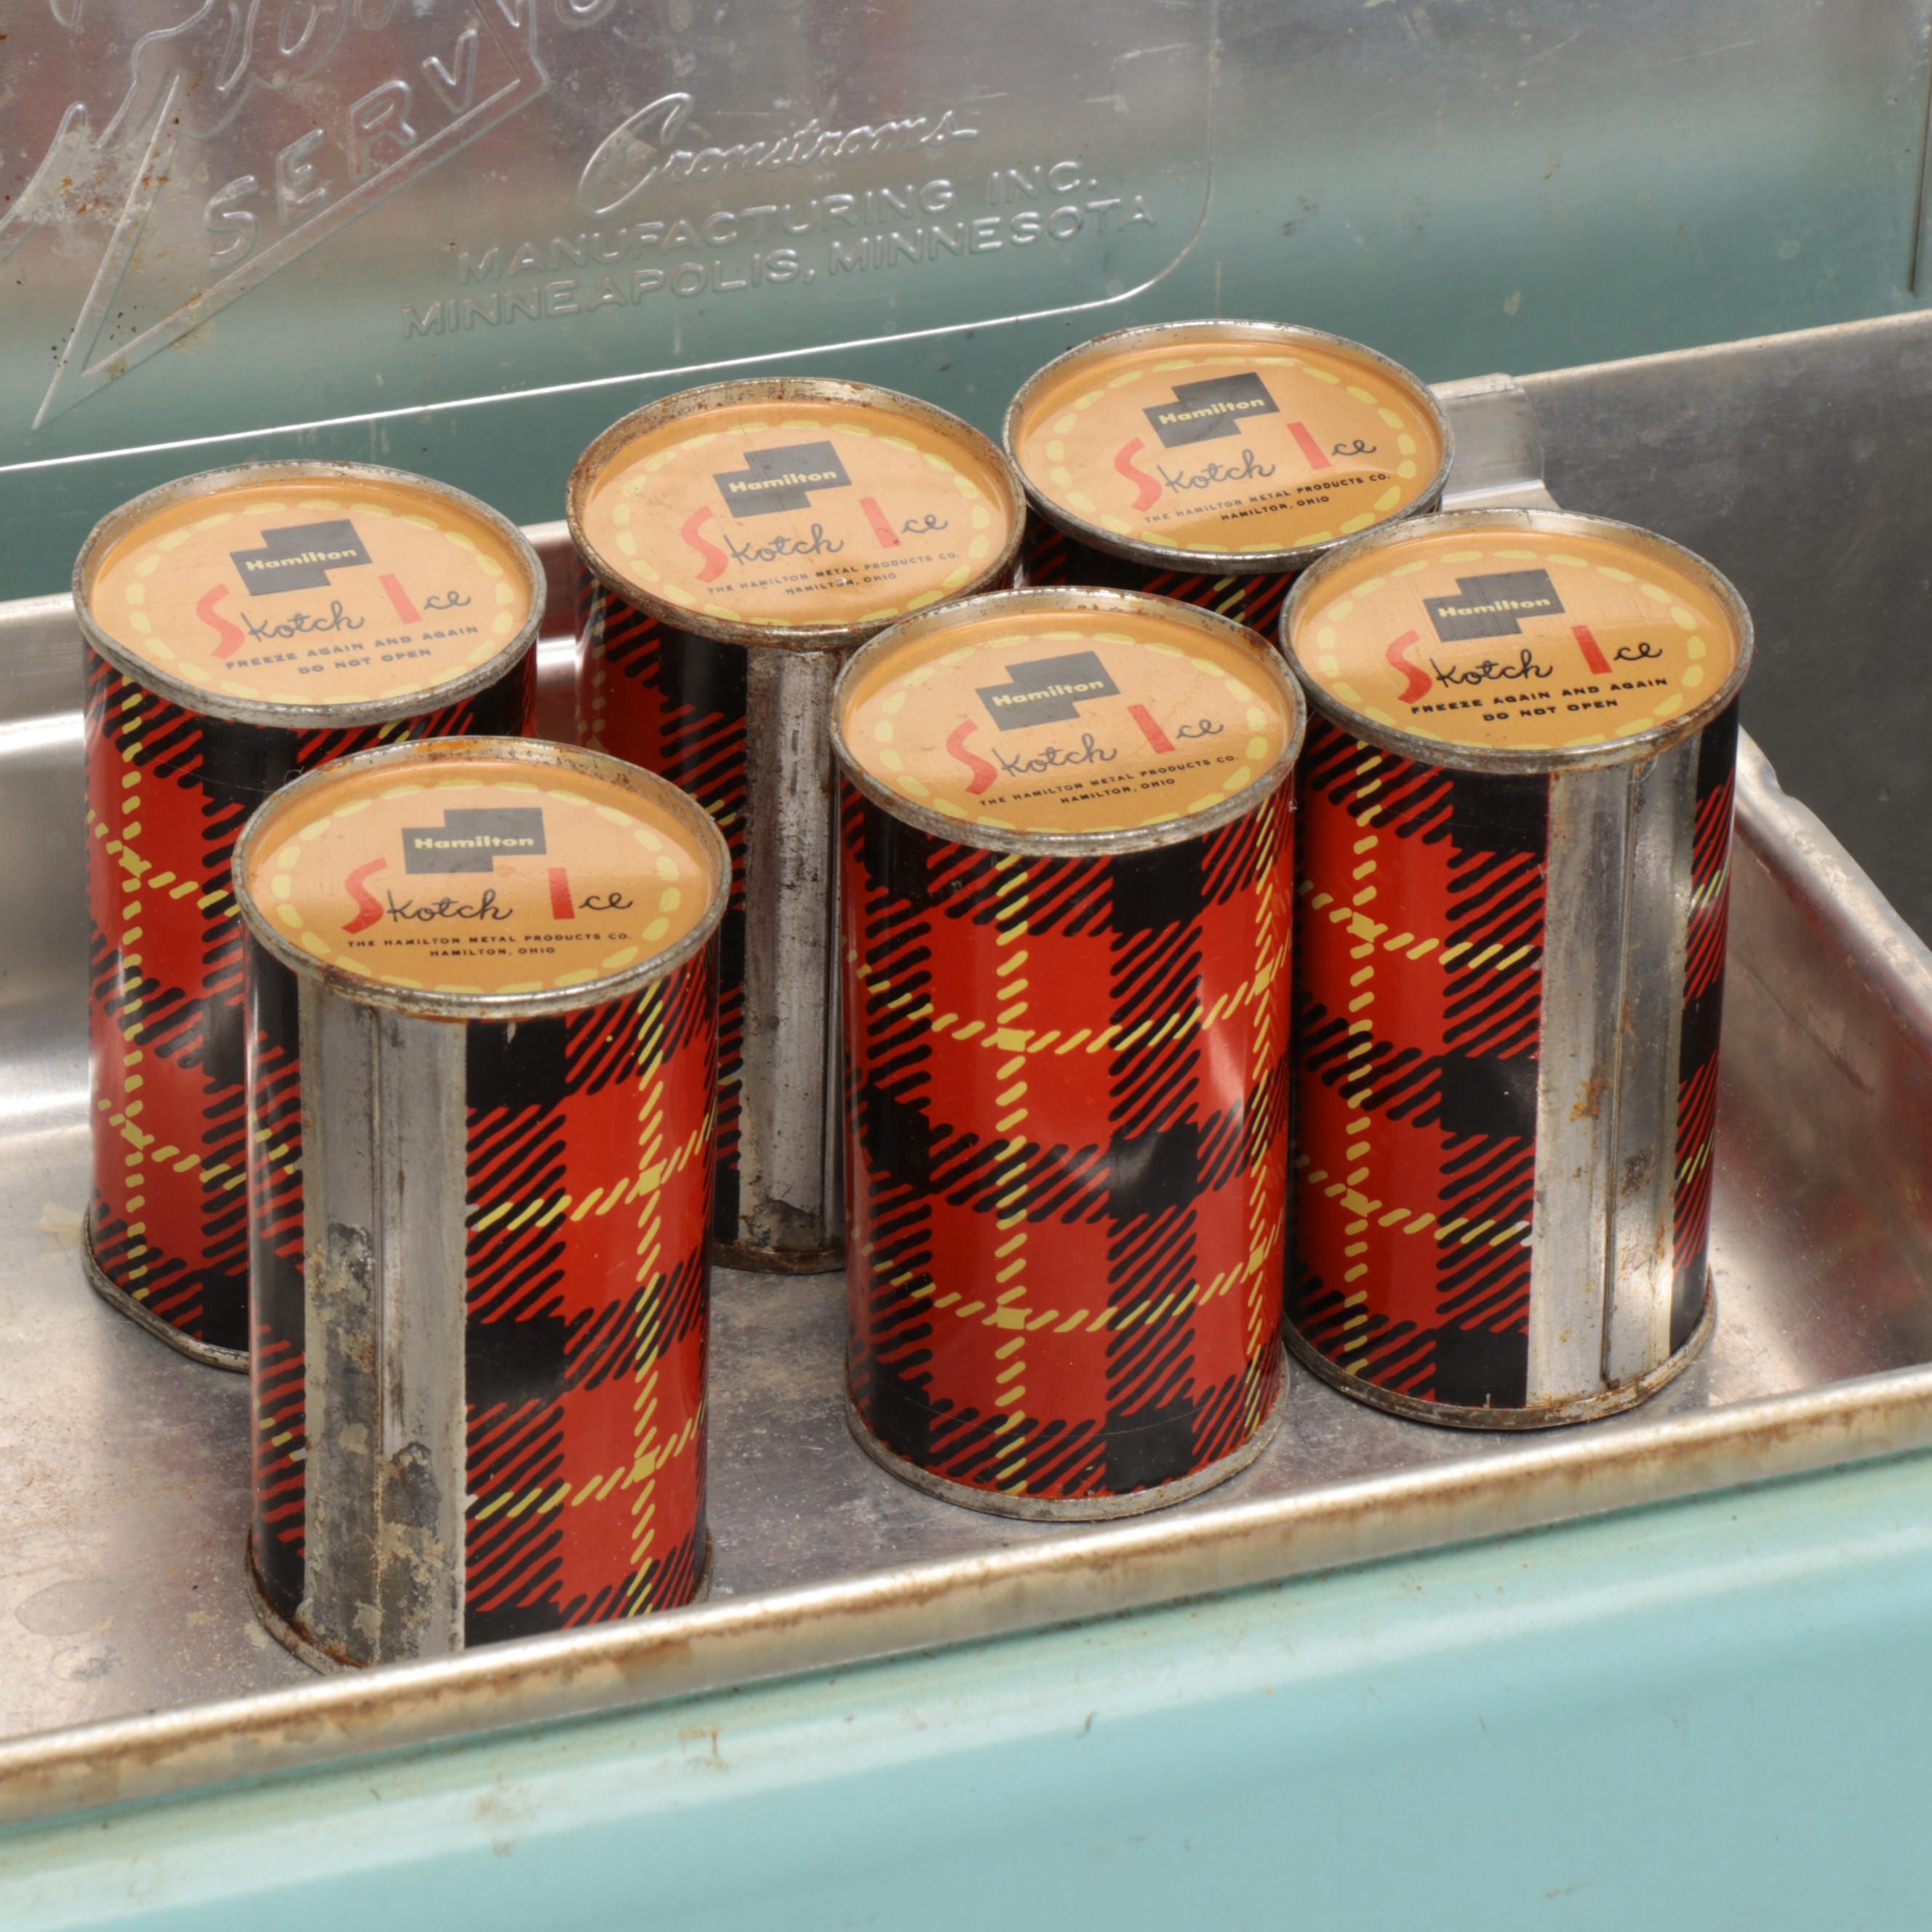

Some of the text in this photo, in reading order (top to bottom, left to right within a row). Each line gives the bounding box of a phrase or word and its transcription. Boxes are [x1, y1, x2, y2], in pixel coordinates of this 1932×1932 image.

[458, 161, 1097, 285] MANUFACTURING INC.
[402, 194, 1157, 339] MINNEAPOLIS, MINNESOTA
[1159, 397, 1265, 425] Hamilton
[728, 469, 837, 493] Hamilton
[1114, 421, 1377, 512] Skotch Ice
[1145, 473, 1391, 524] THE HAMILTON METAL PRODUCTS CO.
[1221, 495, 1330, 521] HAMILTON, OHIO
[681, 496, 948, 583] Skotch Ice
[246, 549, 357, 571] Hamilton
[708, 551, 960, 594] THE HAMILTON METAL PRODUCTS CO.
[863, 573, 897, 583] OHIO
[196, 573, 471, 660] Skotch Ice
[1438, 597, 1551, 618] Hamilton
[225, 626, 479, 669] FREEZE AGAIN AND AGAIN
[298, 648, 431, 675] DO NOT OPEN
[1386, 624, 1663, 704] Skotch Ice
[993, 680, 1104, 706] Hamilton
[1411, 677, 1668, 714] FREEZE AGAIN AND AGAIN
[1483, 699, 1618, 722] DO NOT OPEN
[946, 703, 1224, 795] Skotch Ice
[980, 755, 1240, 807] THE HAMILTON METAL PRODUCTS CO.
[1061, 778, 1175, 805] HAMILTON, OHIO
[415, 836, 535, 850] Hamilton
[341, 857, 634, 935] Skotch Ice
[348, 940, 375, 948] THE
[384, 937, 460, 946] HAMILTON
[469, 935, 516, 943] METAL
[525, 933, 601, 942] PRODUCTS
[431, 948, 512, 957] HAMILTON,
